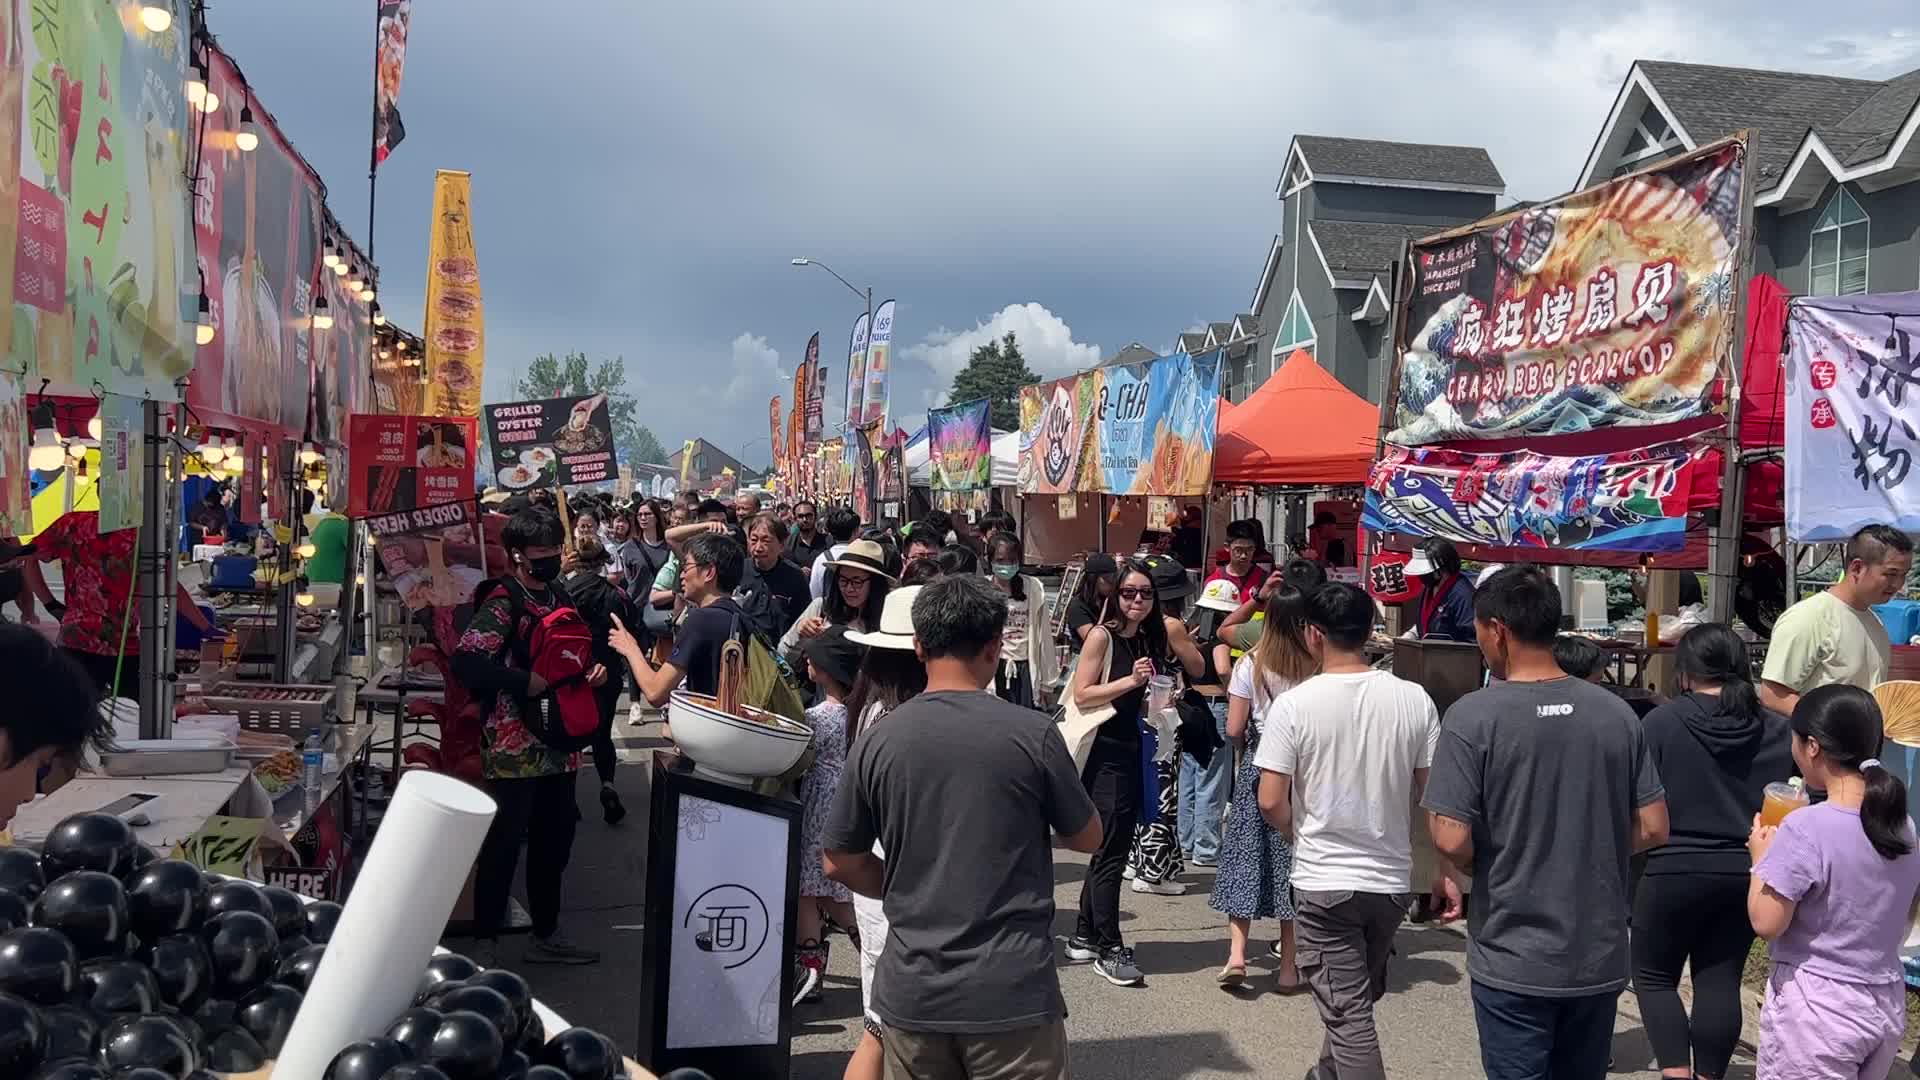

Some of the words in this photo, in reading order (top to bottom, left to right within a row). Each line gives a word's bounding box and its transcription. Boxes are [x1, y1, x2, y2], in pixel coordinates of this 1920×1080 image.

[1424, 265, 1459, 281] JAPANESE
[1460, 258, 1477, 273] STYLE
[1423, 282, 1444, 295] SINCE
[1454, 261, 1675, 355] 疯狂烤扇贝
[871, 333, 890, 341] JUICE
[1447, 370, 1506, 400] CRAZY
[1513, 364, 1555, 394] BBQ
[1566, 341, 1674, 385] SCALLOP
[493, 404, 543, 418] GRILLED
[497, 417, 543, 430] OYSTER
[570, 463, 605, 474] GRILLED
[571, 471, 607, 482] SCALLOP
[1371, 562, 1408, 594] 理
[270, 871, 325, 898] HERE
